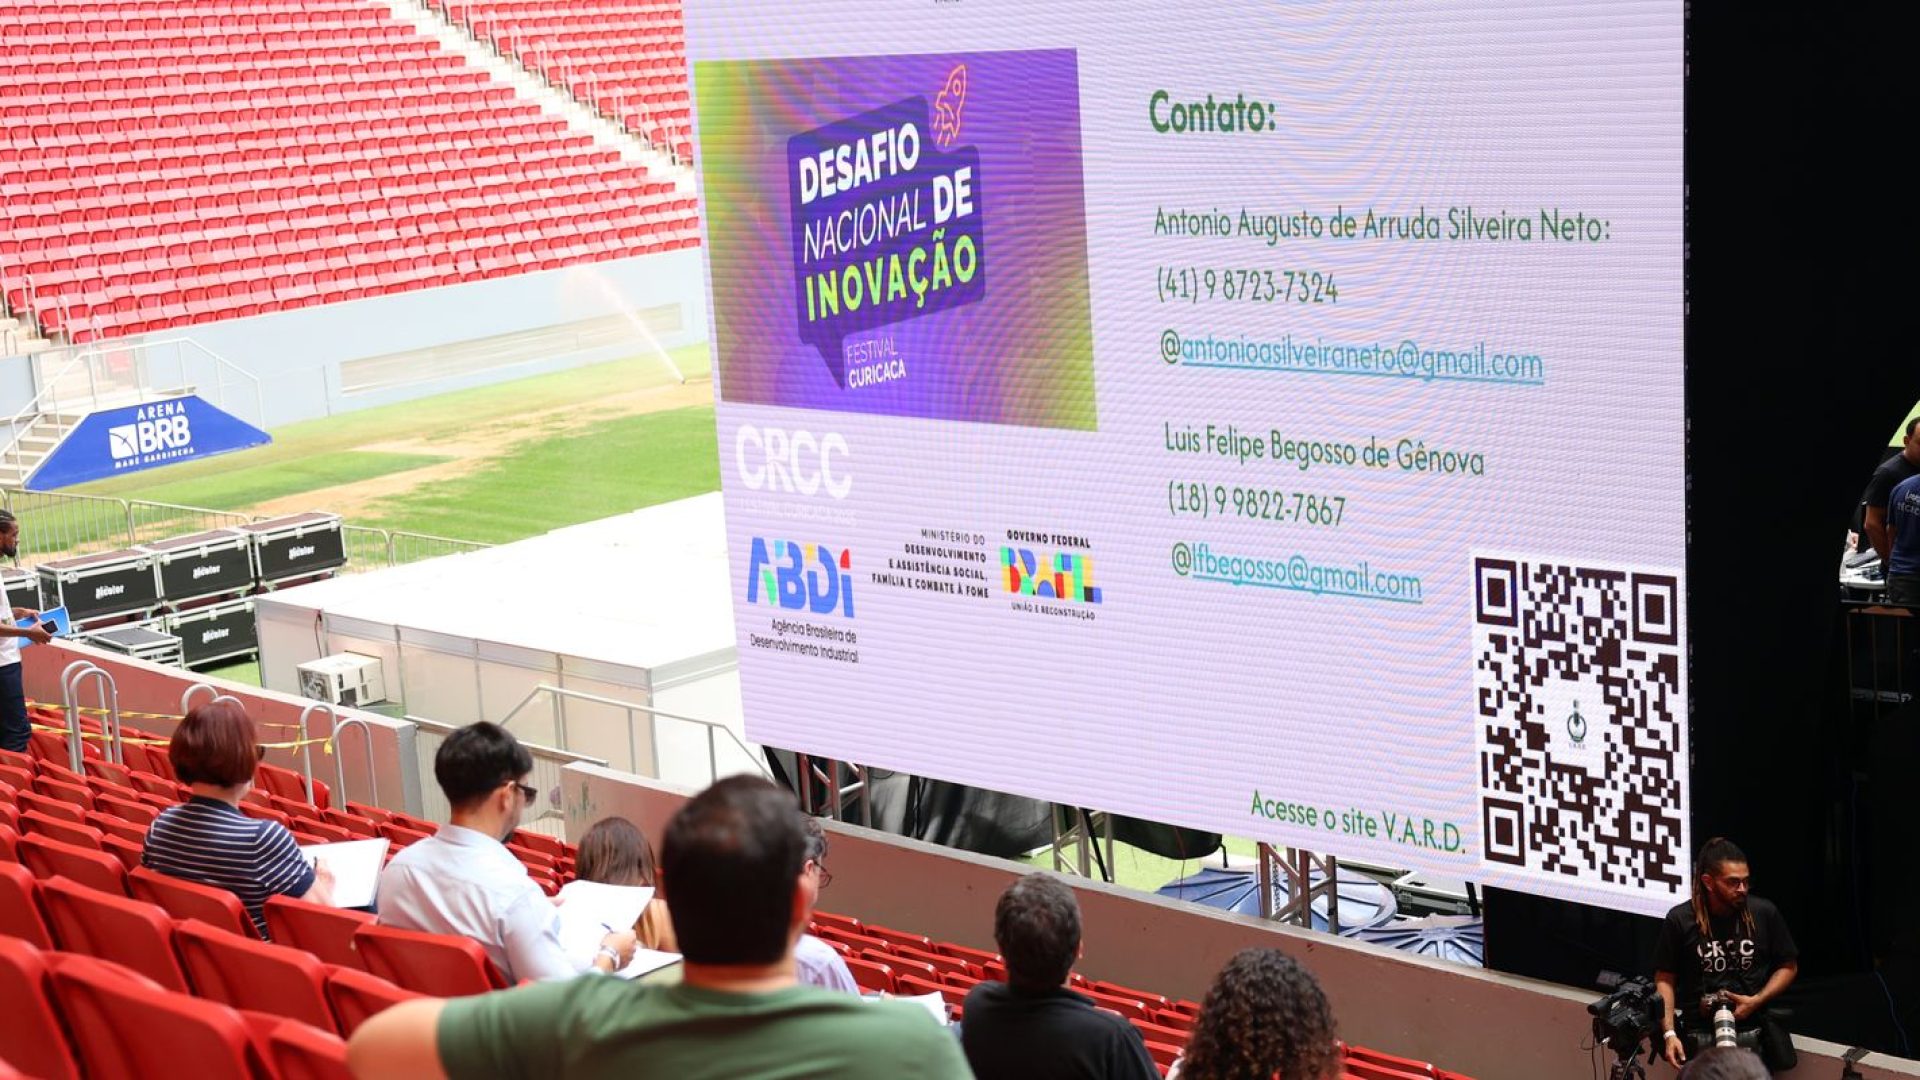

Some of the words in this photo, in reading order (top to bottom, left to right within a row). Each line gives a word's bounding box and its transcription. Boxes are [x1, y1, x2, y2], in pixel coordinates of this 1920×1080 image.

[1149, 90, 1277, 134] Contato:
[799, 123, 920, 205] DESAFIO
[803, 188, 926, 264] NACIONAL
[932, 166, 973, 224] DE
[1154, 206, 1231, 237] Antonio
[1237, 207, 1323, 246] Augusto
[1329, 206, 1357, 239] de
[1363, 208, 1440, 240] Arruda
[1447, 208, 1532, 241] Silveira
[1540, 208, 1611, 242] Neto:
[806, 227, 977, 322] INOVAÇÃO
[1157, 267, 1198, 304] (41)
[1204, 270, 1216, 300] 9
[1223, 270, 1339, 303] 8723-7324
[847, 336, 898, 365] FESTIVAL
[1160, 329, 1544, 382] @antonioasilveiraneto@gmail.com
[849, 358, 907, 388] CURICACA
[137, 401, 186, 420] ARENA
[138, 415, 191, 453] BRB
[1165, 422, 1201, 454] Luis
[1206, 426, 1265, 465] Felipe
[1270, 430, 1357, 471] Begosso
[1363, 436, 1390, 468] de
[1396, 439, 1485, 475] Gênova
[736, 424, 853, 499] CRCC
[1168, 480, 1208, 519] (18)
[1214, 486, 1227, 515] 9
[1232, 488, 1346, 526] 9822-7867
[905, 544, 986, 563] DESENVOLVIMENTO
[921, 528, 970, 544] MINISTÉRIO
[973, 534, 985, 545] DO
[1007, 529, 1048, 544] GOVERNO
[1051, 534, 1091, 548] FEDERAL
[889, 558, 894, 568] E
[896, 560, 951, 575] ASSISTÊNCIA
[1172, 541, 1422, 599] @lfbegosso@gmail.com
[872, 573, 905, 587] FAMÍLIA
[908, 578, 912, 588] E
[915, 579, 954, 594] COMBATE
[966, 586, 989, 598] FOME
[771, 618, 805, 636] Agência
[806, 624, 844, 642] Brasileira
[845, 629, 857, 643] de
[1041, 605, 1096, 621] RECONSTRUÇÃO
[750, 633, 819, 656] Desenvolvimento
[820, 645, 859, 663] Industrial
[1251, 789, 1318, 827] Acesse
[1324, 811, 1336, 831] o
[1342, 809, 1378, 836] site
[1384, 813, 1466, 854] V.A.R.D.
